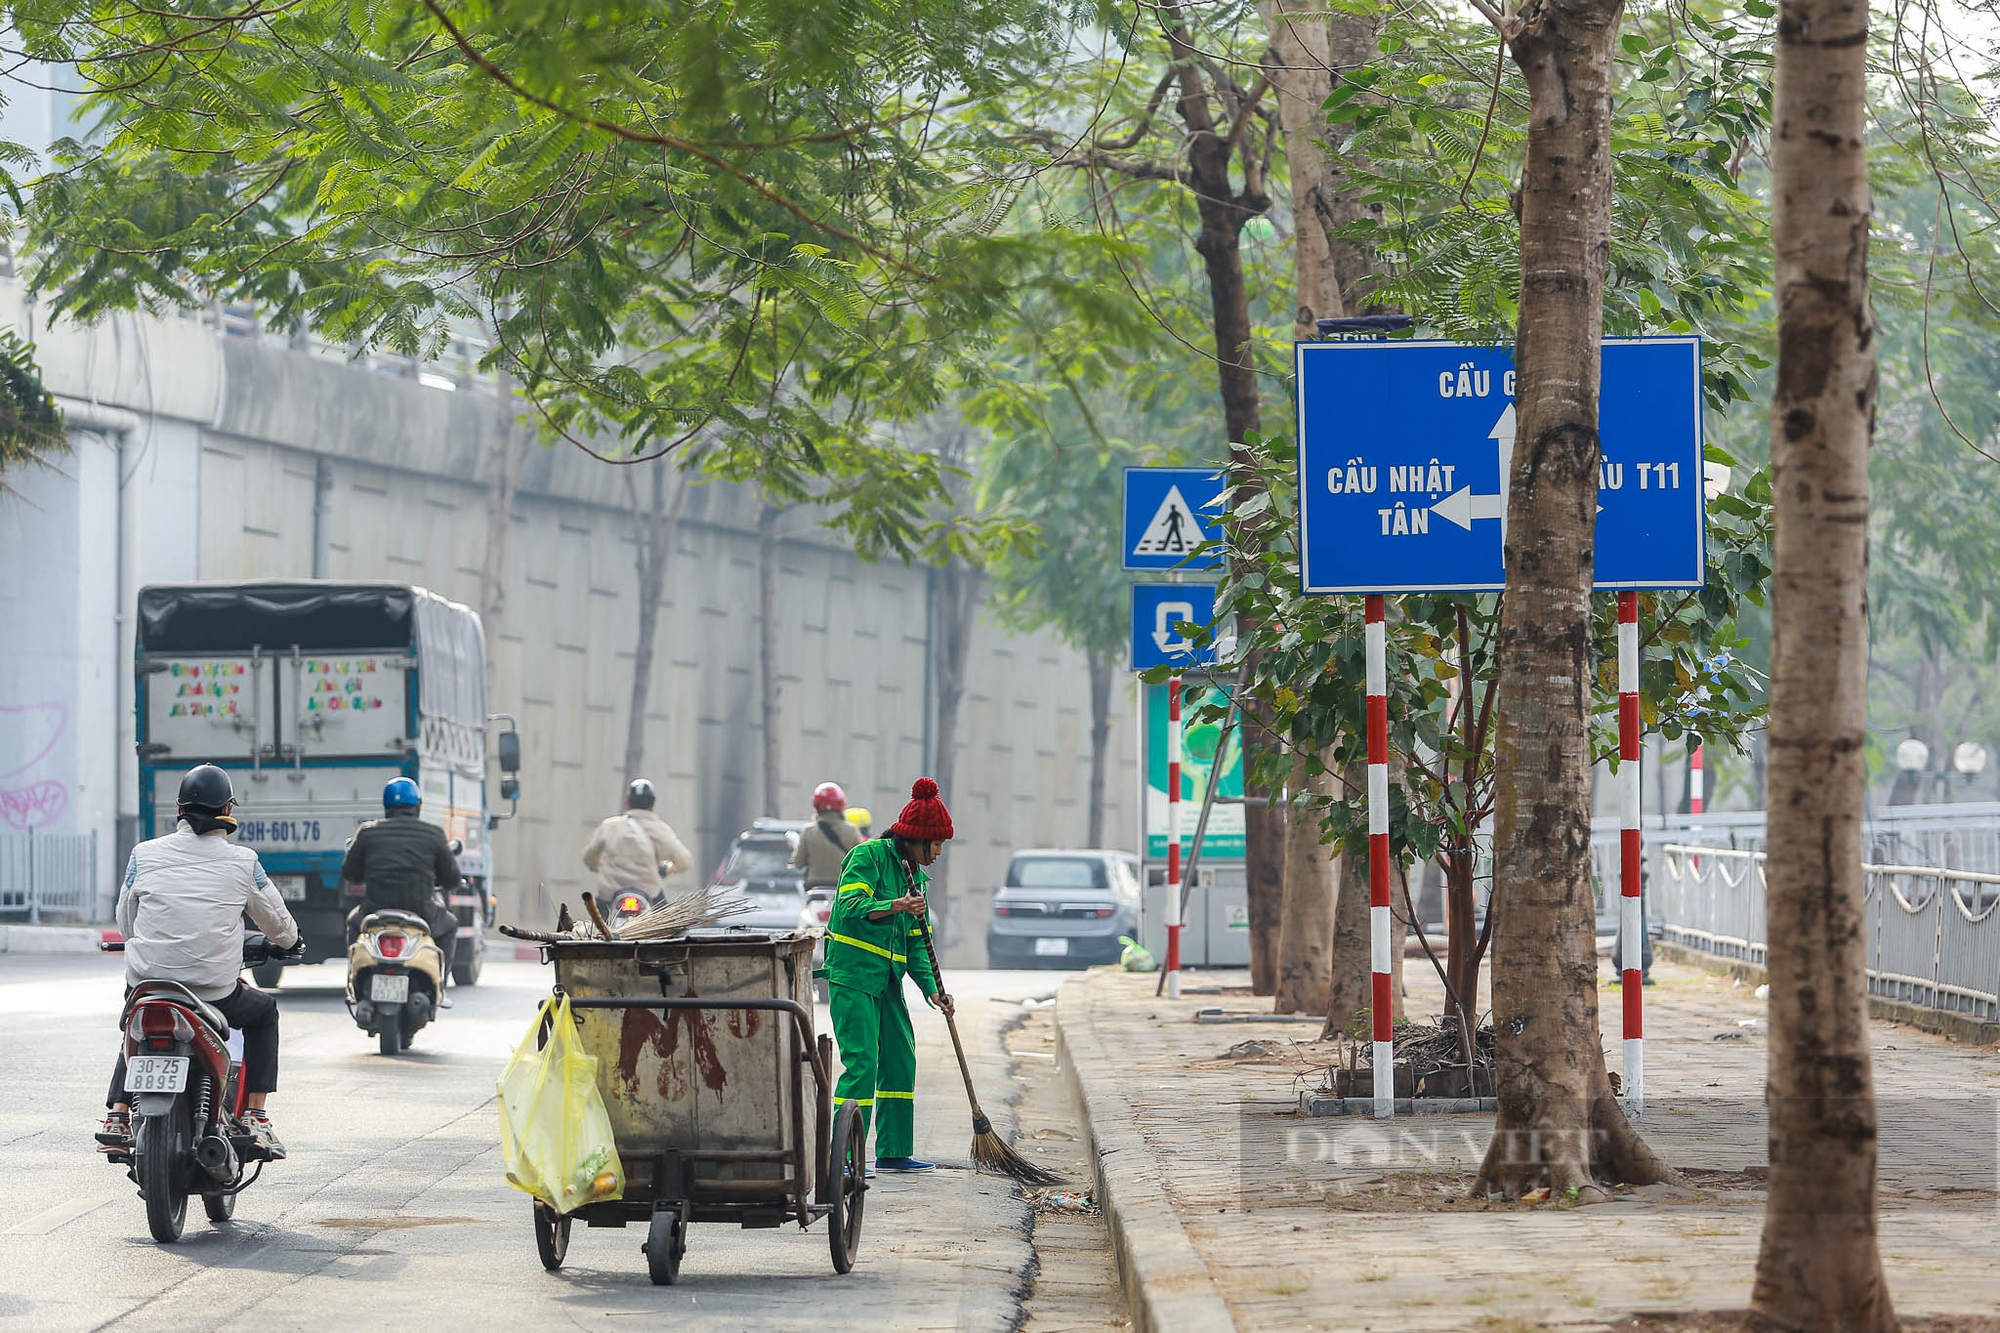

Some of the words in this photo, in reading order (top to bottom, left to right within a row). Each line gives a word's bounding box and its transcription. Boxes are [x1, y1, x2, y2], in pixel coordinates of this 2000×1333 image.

[1439, 362, 1490, 398] CẦU
[1327, 456, 1377, 494] CẦU
[1389, 457, 1456, 500] NHẬT
[1637, 462, 1680, 490] T11
[1378, 501, 1429, 536] TÂN
[238, 820, 321, 842] 29H-601.76
[137, 1059, 180, 1074] 30-Z5
[134, 1075, 177, 1090] 8895
